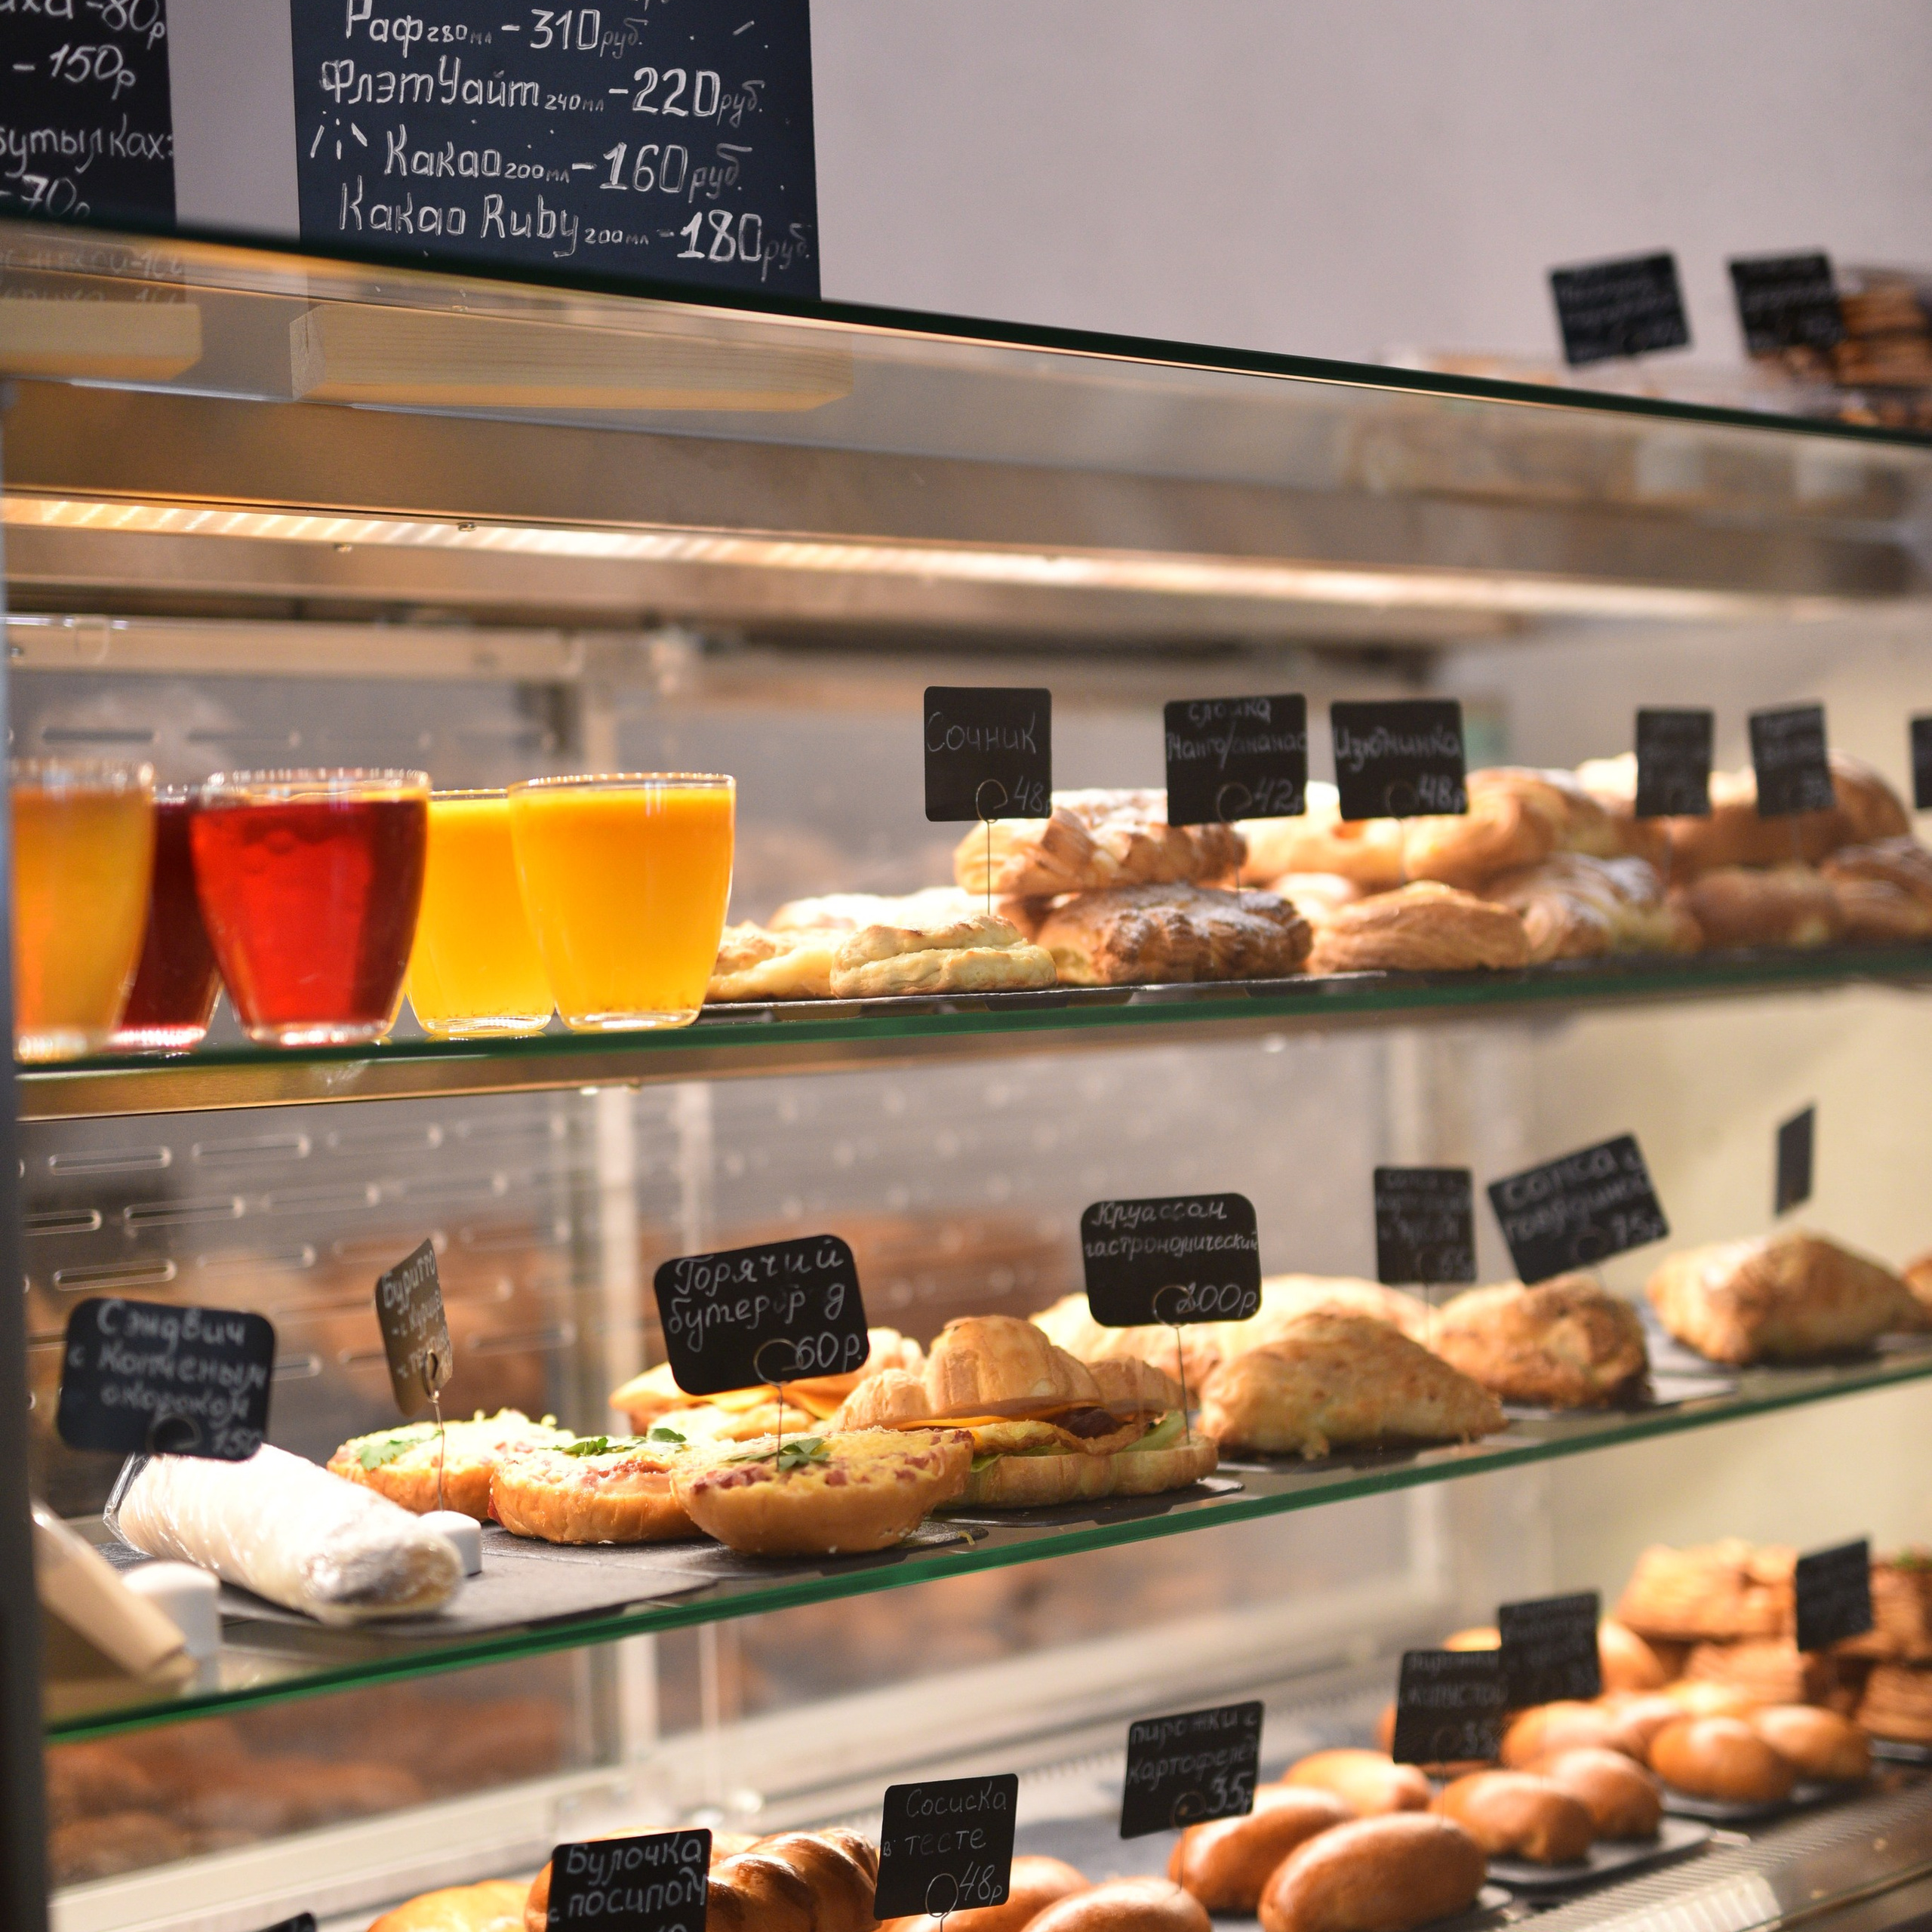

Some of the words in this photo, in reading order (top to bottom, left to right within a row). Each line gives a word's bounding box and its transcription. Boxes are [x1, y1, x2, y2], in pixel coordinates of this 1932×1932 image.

[383, 123, 502, 177] Какао
[339, 174, 466, 236] Какао
[480, 192, 579, 258] Ruby
[926, 711, 1038, 754] Сочник
[1092, 1201, 1227, 1229] Круассан
[674, 1238, 844, 1297] Горячий
[668, 1282, 845, 1353] бутеррд
[906, 1780, 1008, 1818] Сосиска
[566, 1832, 703, 1887] Булочка
[904, 1827, 987, 1856] тесте
